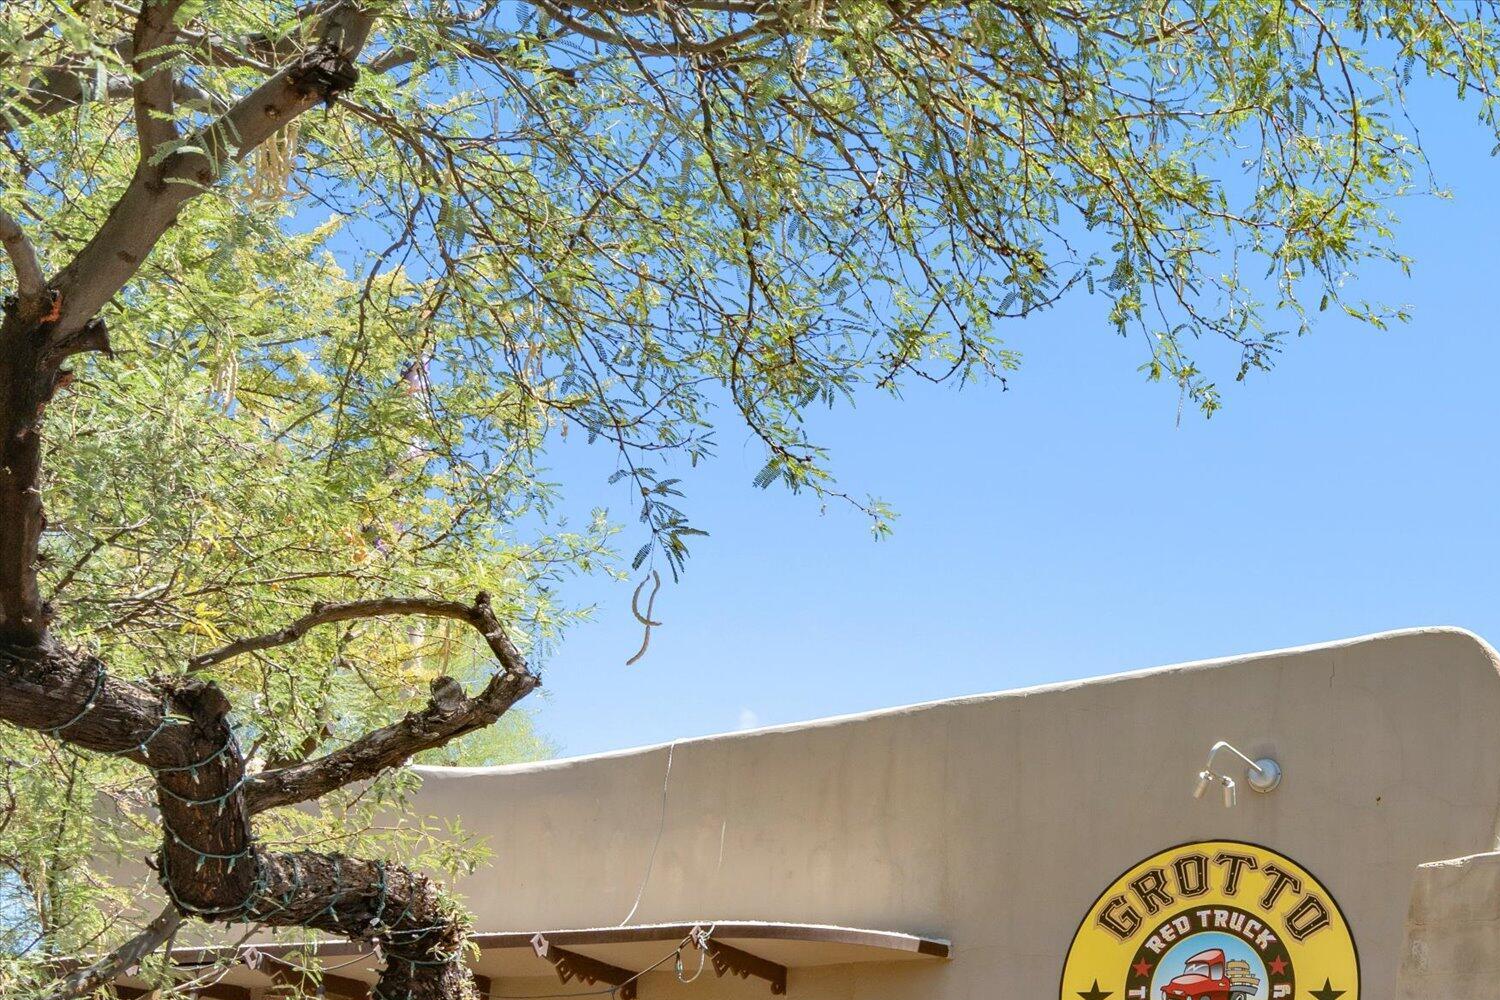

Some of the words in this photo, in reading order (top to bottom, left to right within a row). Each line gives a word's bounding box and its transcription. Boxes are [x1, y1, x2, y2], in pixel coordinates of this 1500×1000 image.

[1096, 851, 1332, 942] GROTTO
[1144, 914, 1191, 955] RED
[1197, 909, 1279, 953] TRUCK
